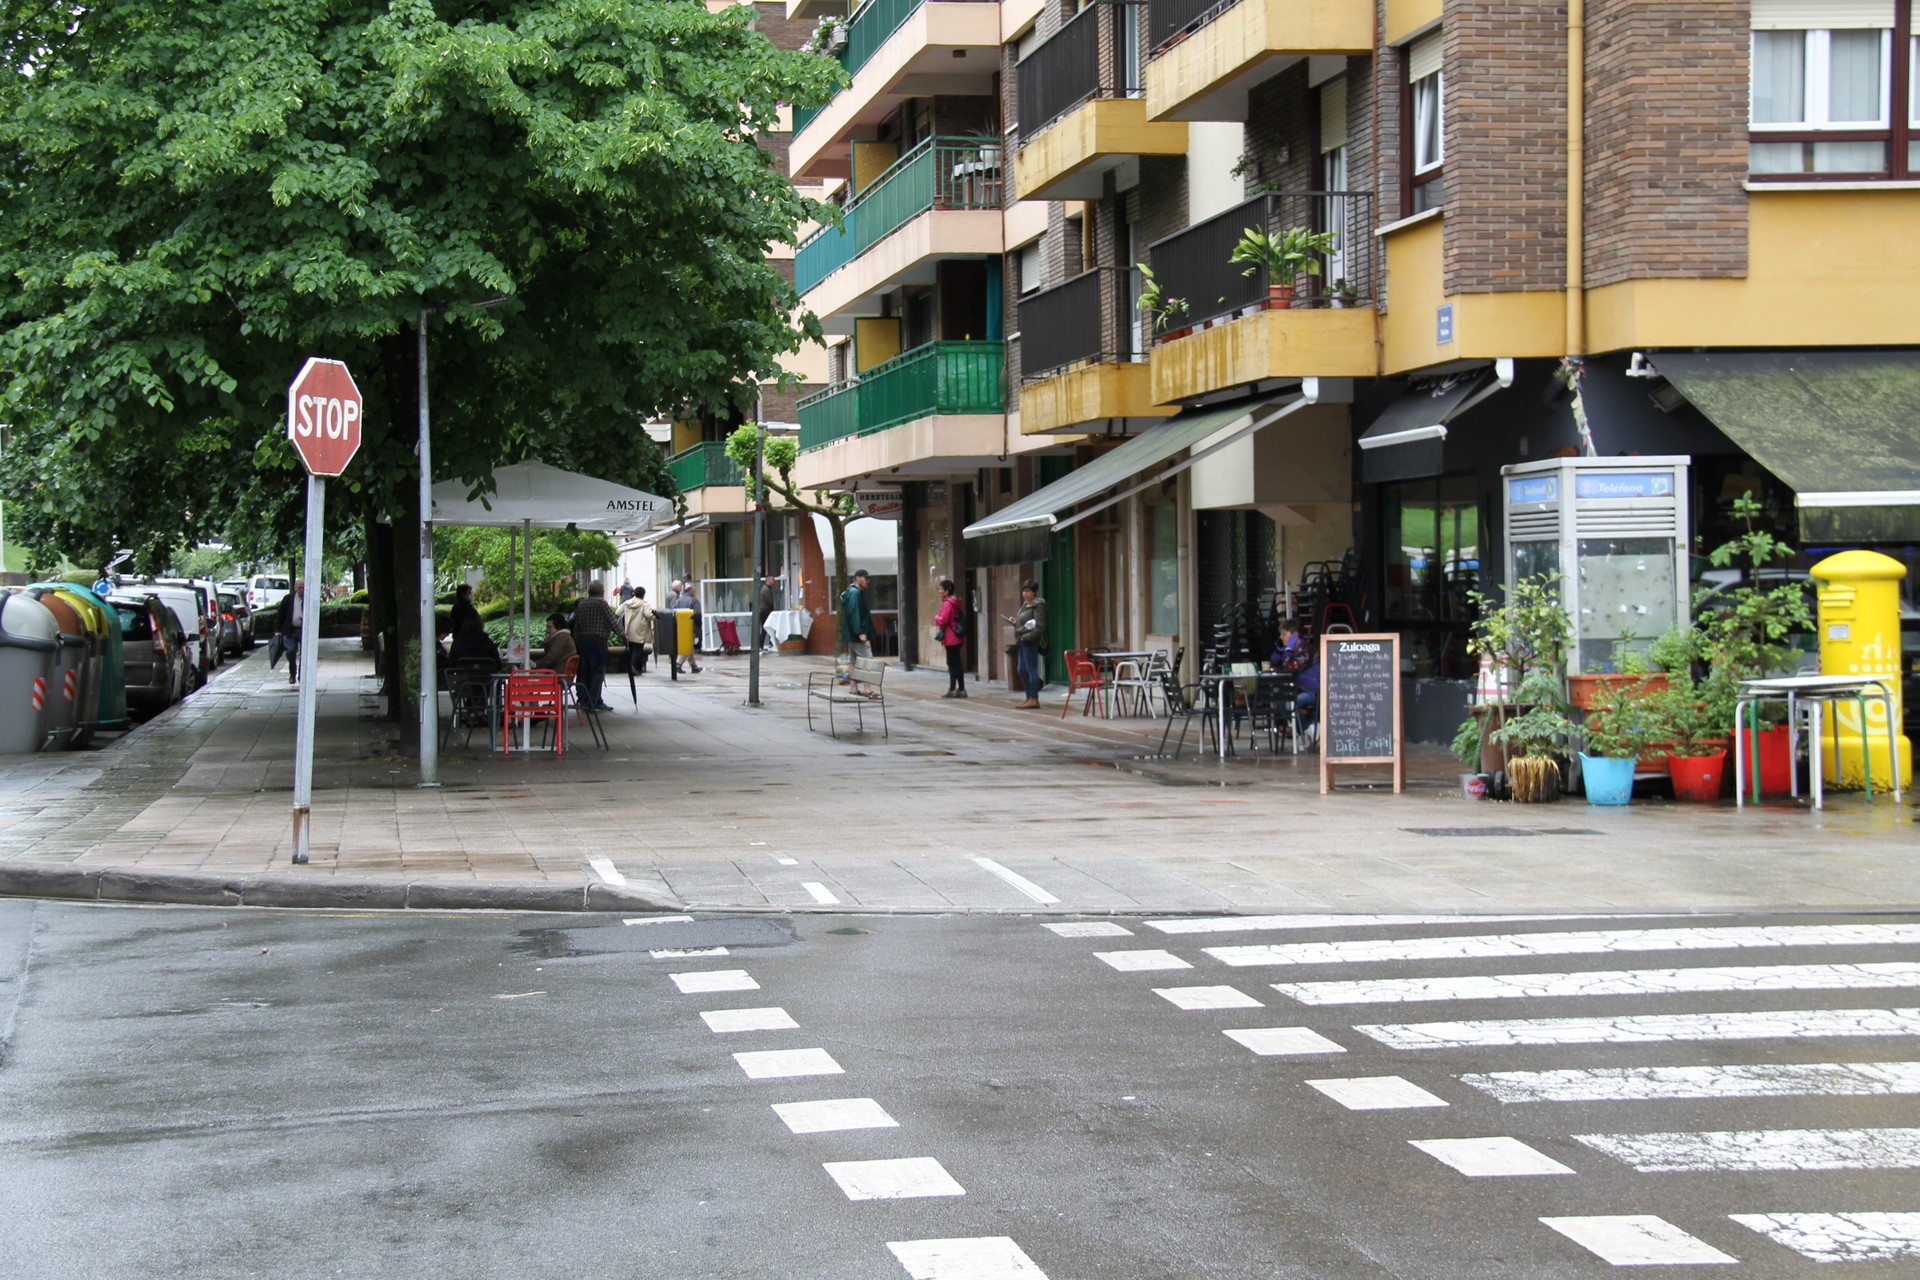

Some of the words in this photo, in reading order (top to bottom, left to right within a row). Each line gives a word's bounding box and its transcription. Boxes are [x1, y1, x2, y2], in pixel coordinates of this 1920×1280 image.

[297, 394, 359, 441] STOP
[1598, 482, 1644, 493] Teléfono
[607, 500, 655, 511] AMSTEL
[868, 502, 900, 514] Benito
[1340, 642, 1380, 653] Zuloaga
